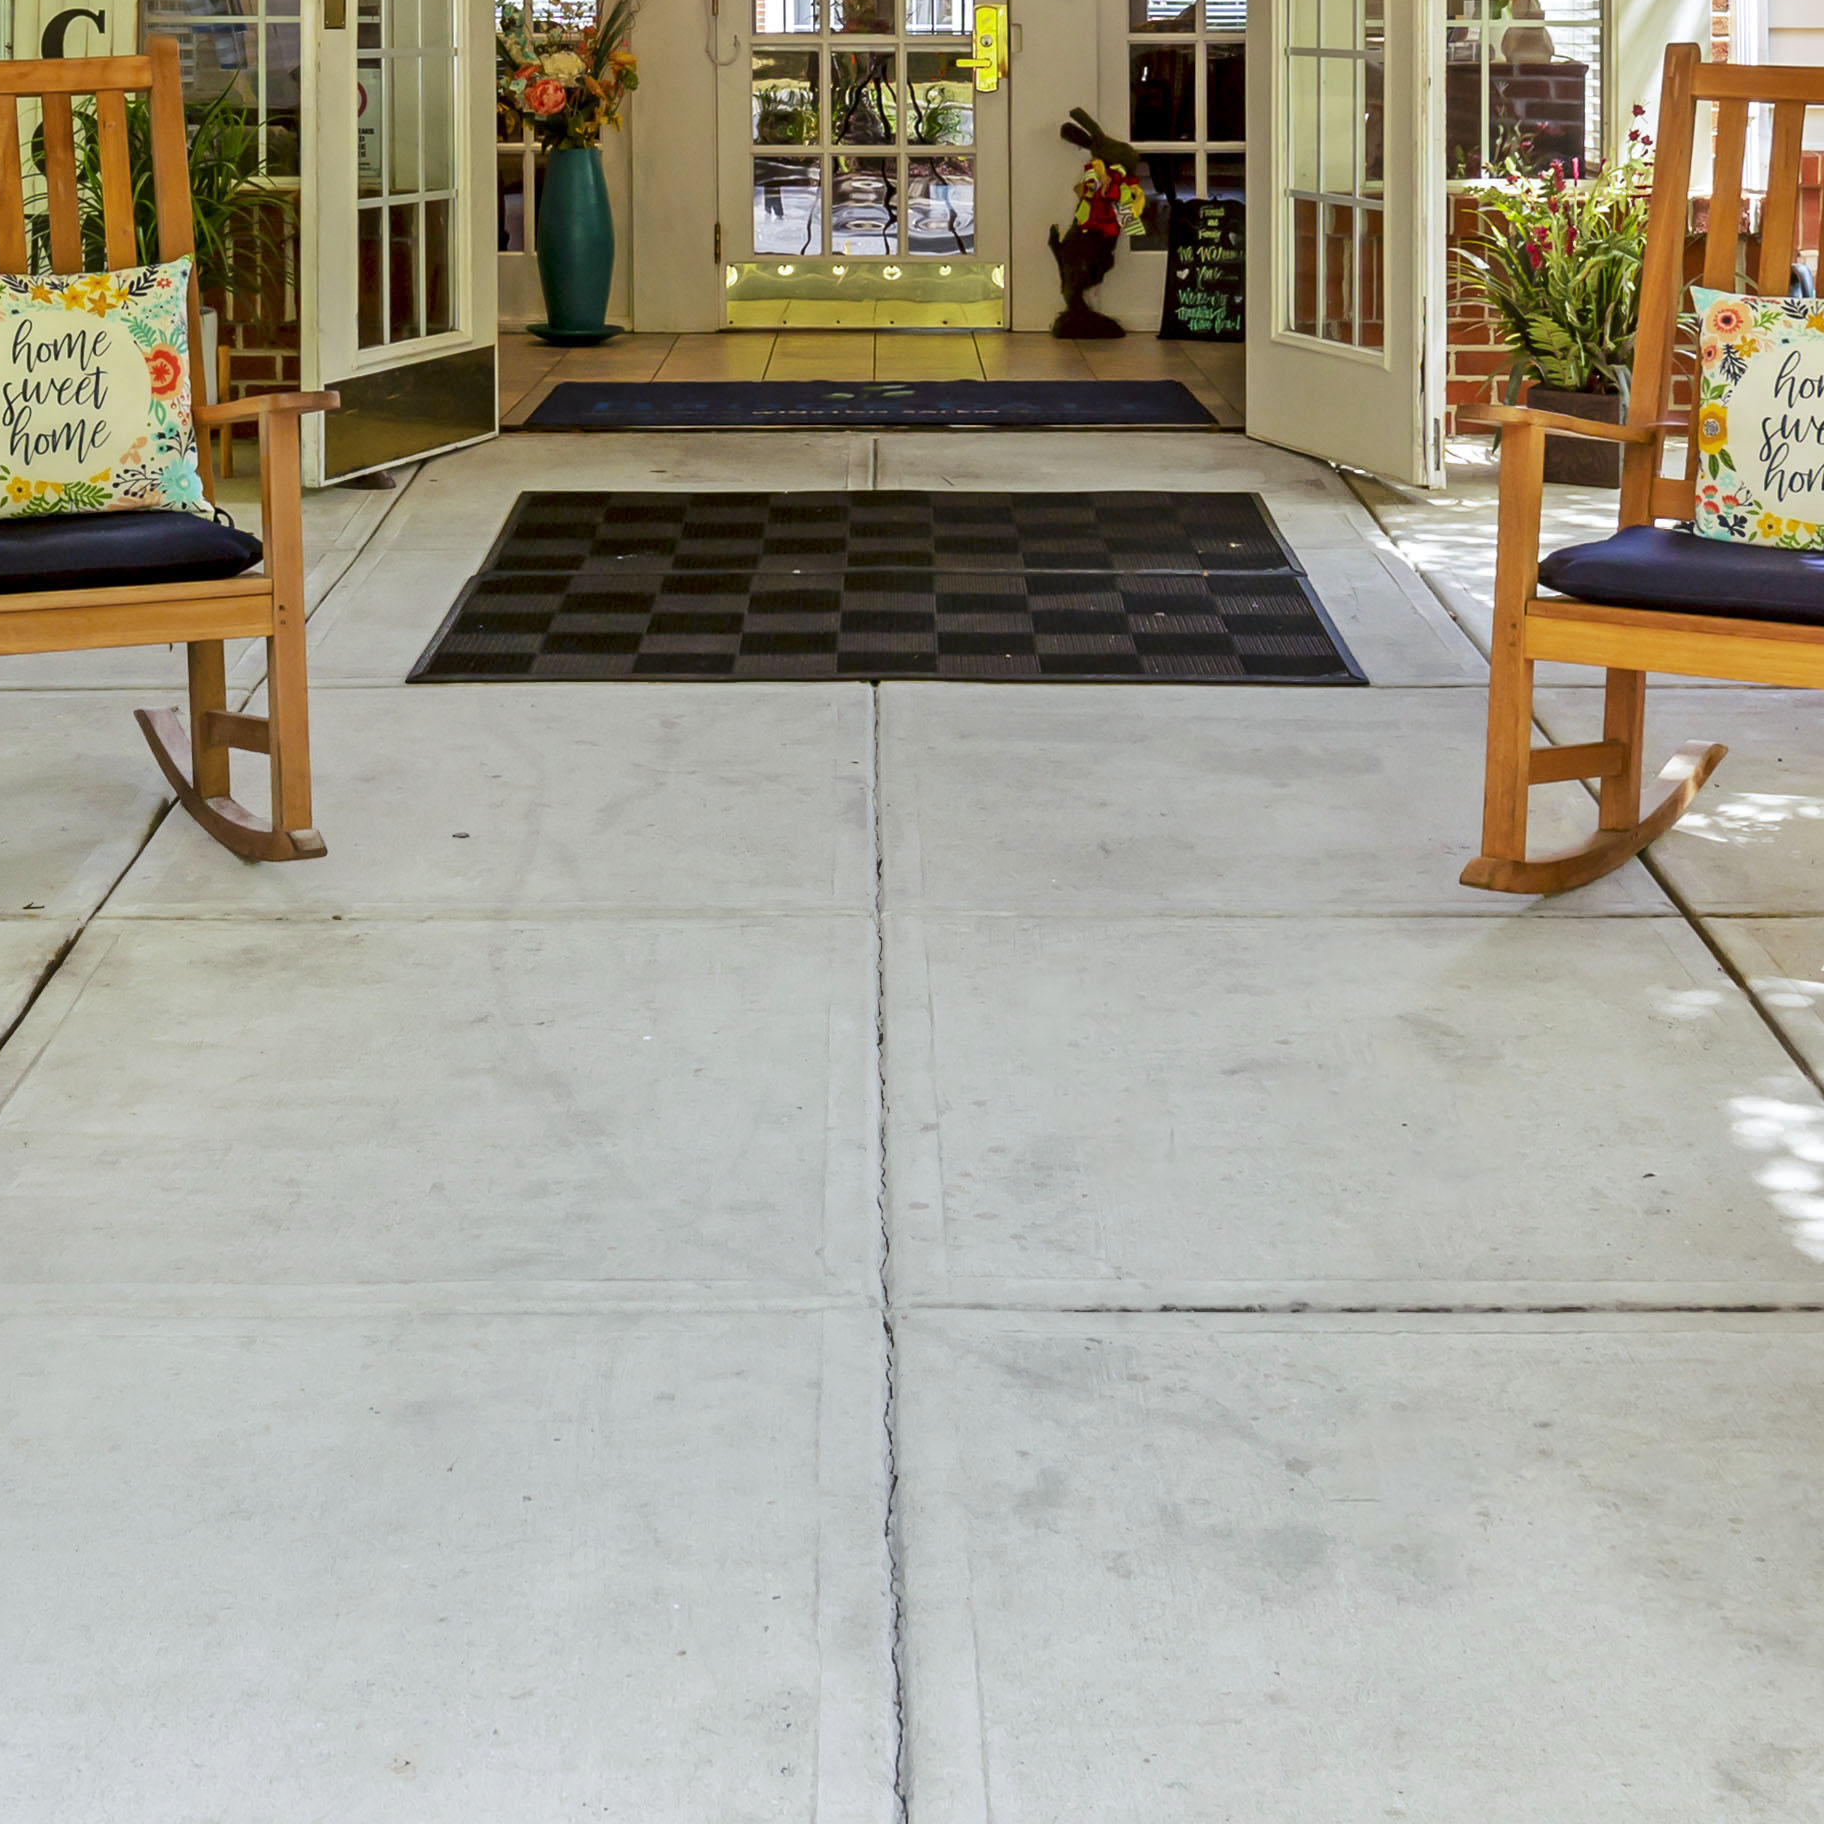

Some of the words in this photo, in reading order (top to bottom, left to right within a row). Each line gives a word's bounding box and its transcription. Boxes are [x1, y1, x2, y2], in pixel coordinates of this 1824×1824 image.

[11, 319, 112, 373] home
[2, 366, 108, 426] sweet
[9, 405, 112, 466] home
